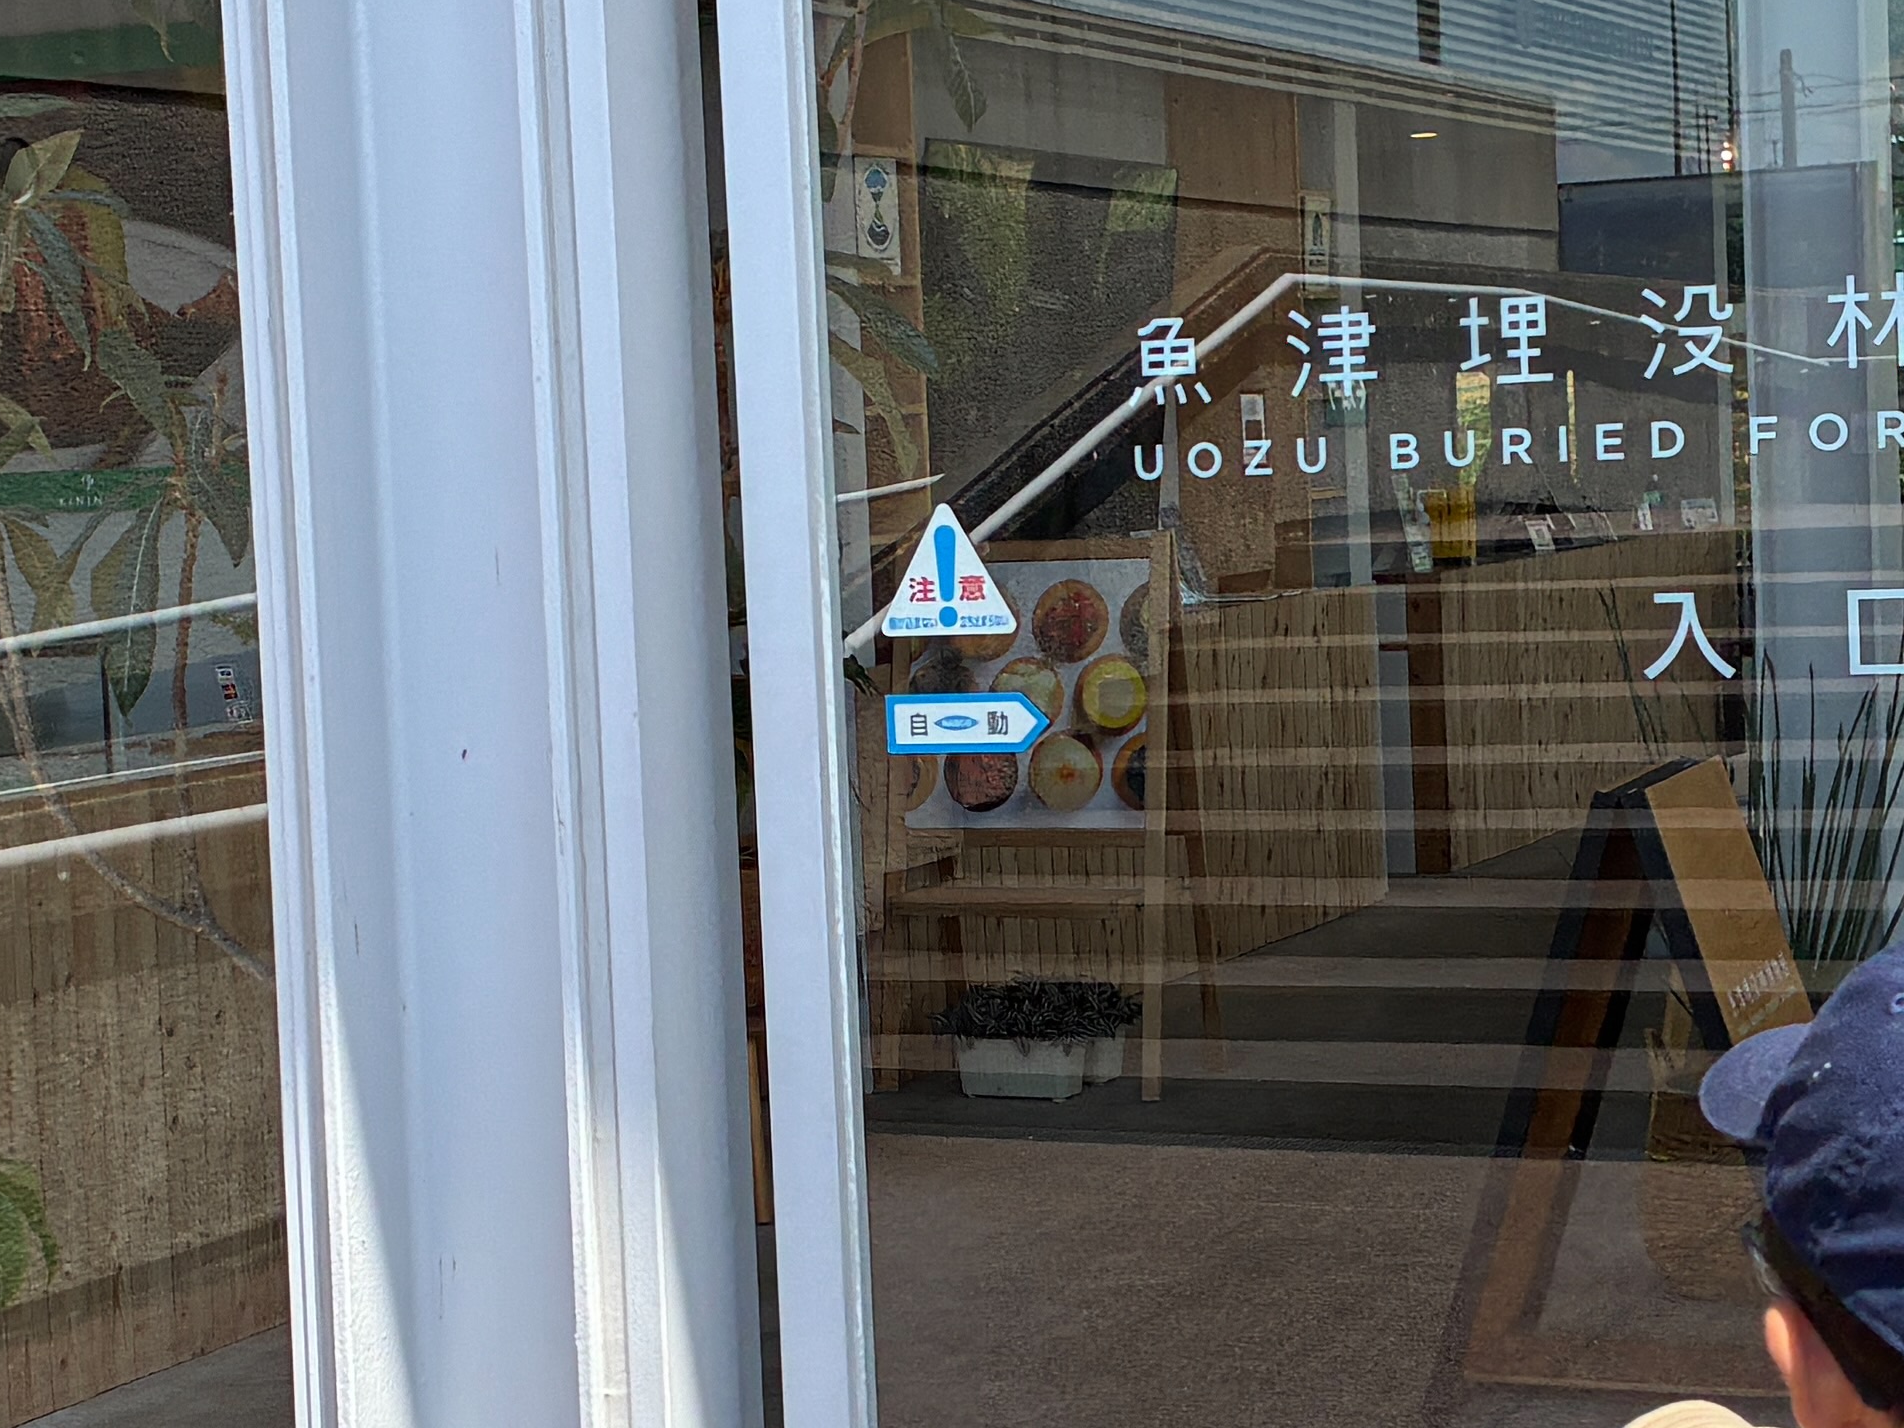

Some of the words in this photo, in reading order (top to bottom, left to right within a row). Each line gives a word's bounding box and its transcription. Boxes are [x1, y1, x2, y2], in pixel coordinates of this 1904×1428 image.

[1133, 436, 1328, 481] UOZU
[1389, 420, 1685, 470] BURIED
[908, 575, 986, 603] 注意
[910, 711, 1009, 737] 自動
